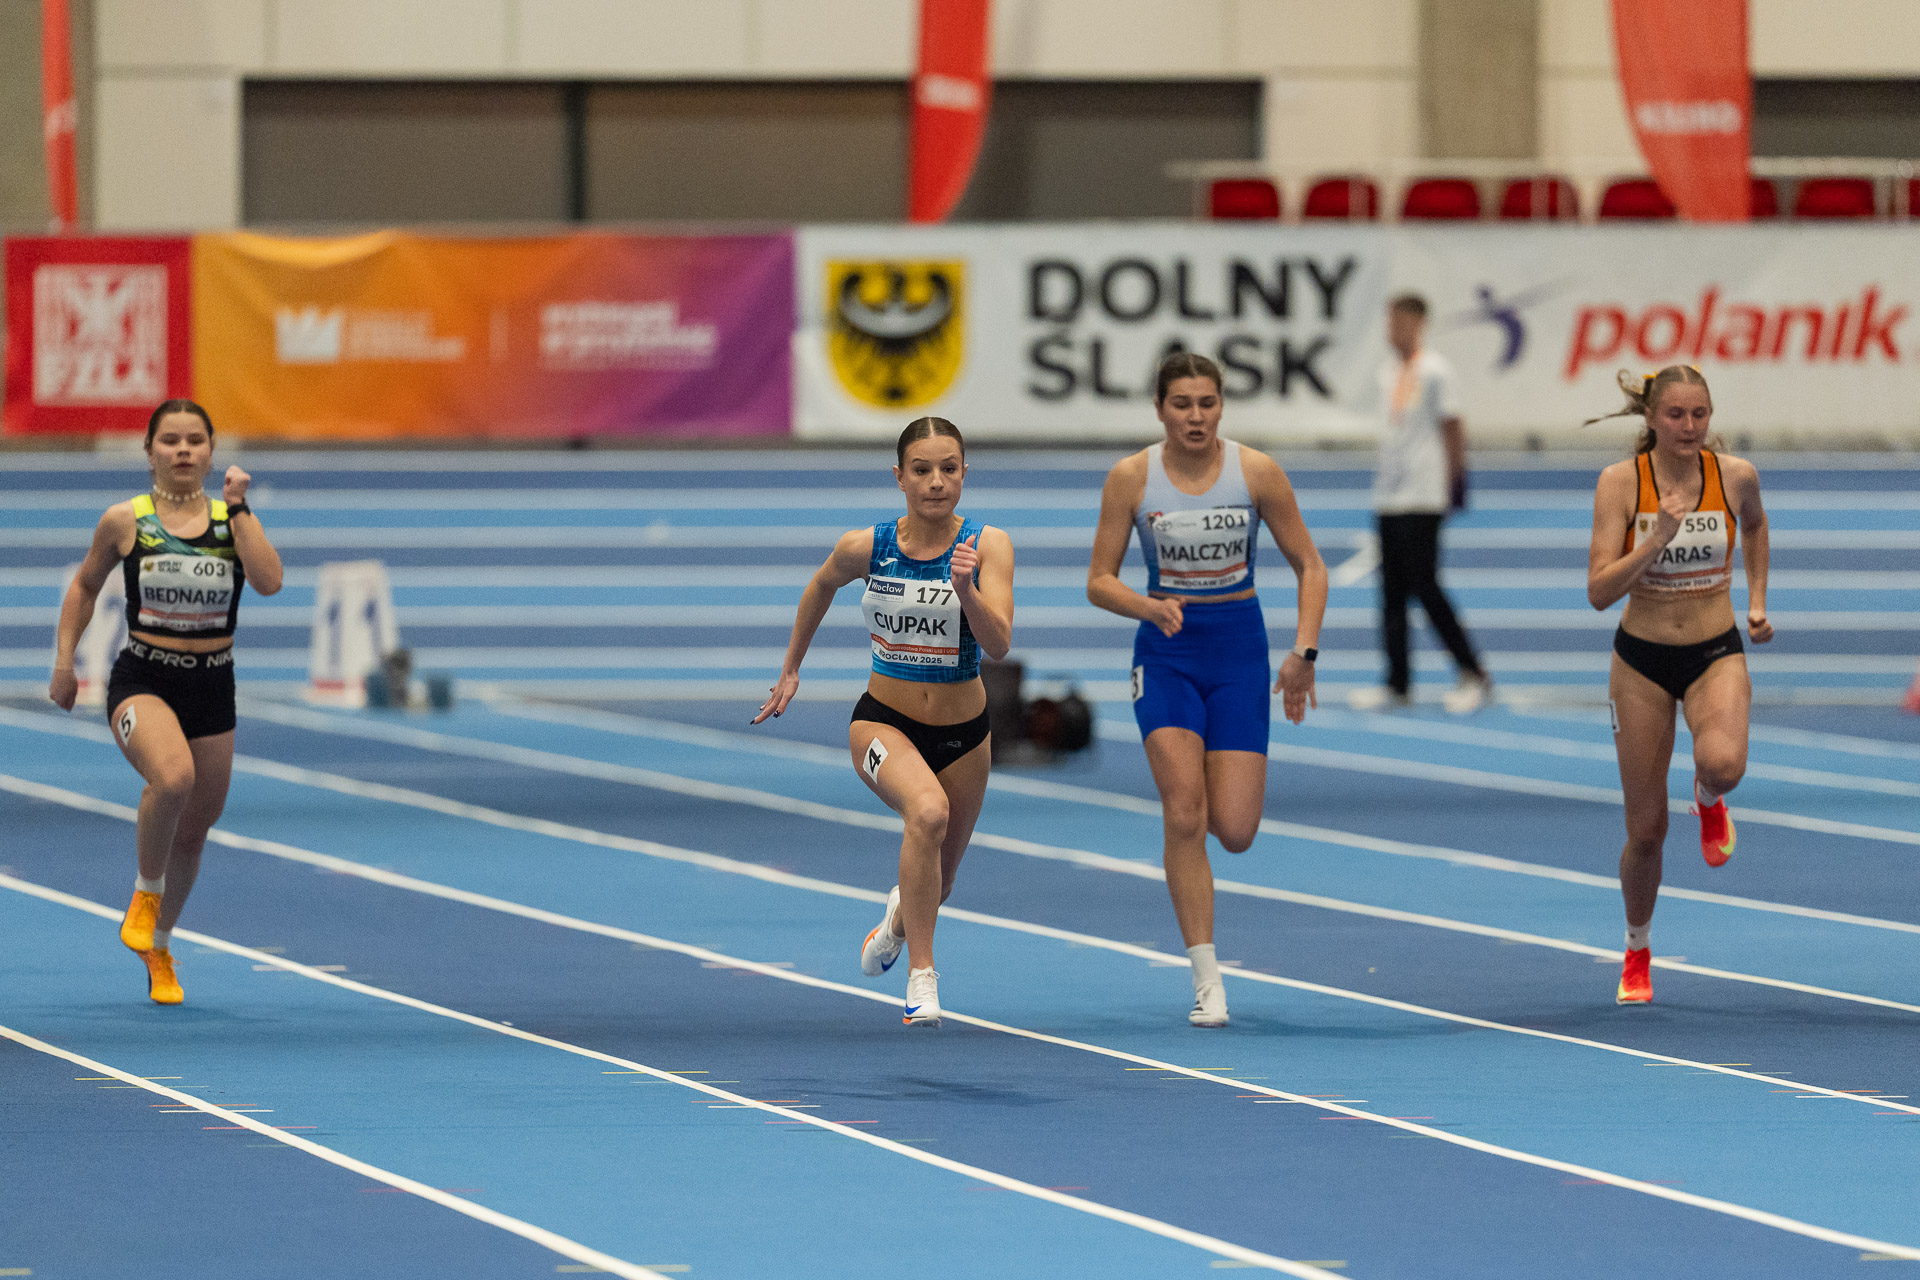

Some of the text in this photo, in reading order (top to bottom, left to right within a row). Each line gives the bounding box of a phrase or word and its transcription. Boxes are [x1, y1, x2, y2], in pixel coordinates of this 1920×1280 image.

[1027, 257, 1356, 323] DOLNY
[1562, 285, 1908, 381] polanik
[1027, 324, 1332, 401] ŚLSK
[1202, 513, 1246, 531] 1201
[1685, 517, 1718, 533] 550
[1160, 538, 1244, 563] MALCZYK
[1653, 545, 1712, 565] ARAS
[193, 562, 226, 577] 603
[144, 587, 230, 605] BEDNARZ
[870, 580, 903, 594] Wrocław
[916, 586, 954, 606] 177
[873, 611, 948, 637] CIUPAK
[149, 648, 198, 669] PRO
[879, 648, 943, 665] WROCŁAW 2025
[121, 712, 131, 738] 5
[868, 747, 882, 774] 4
